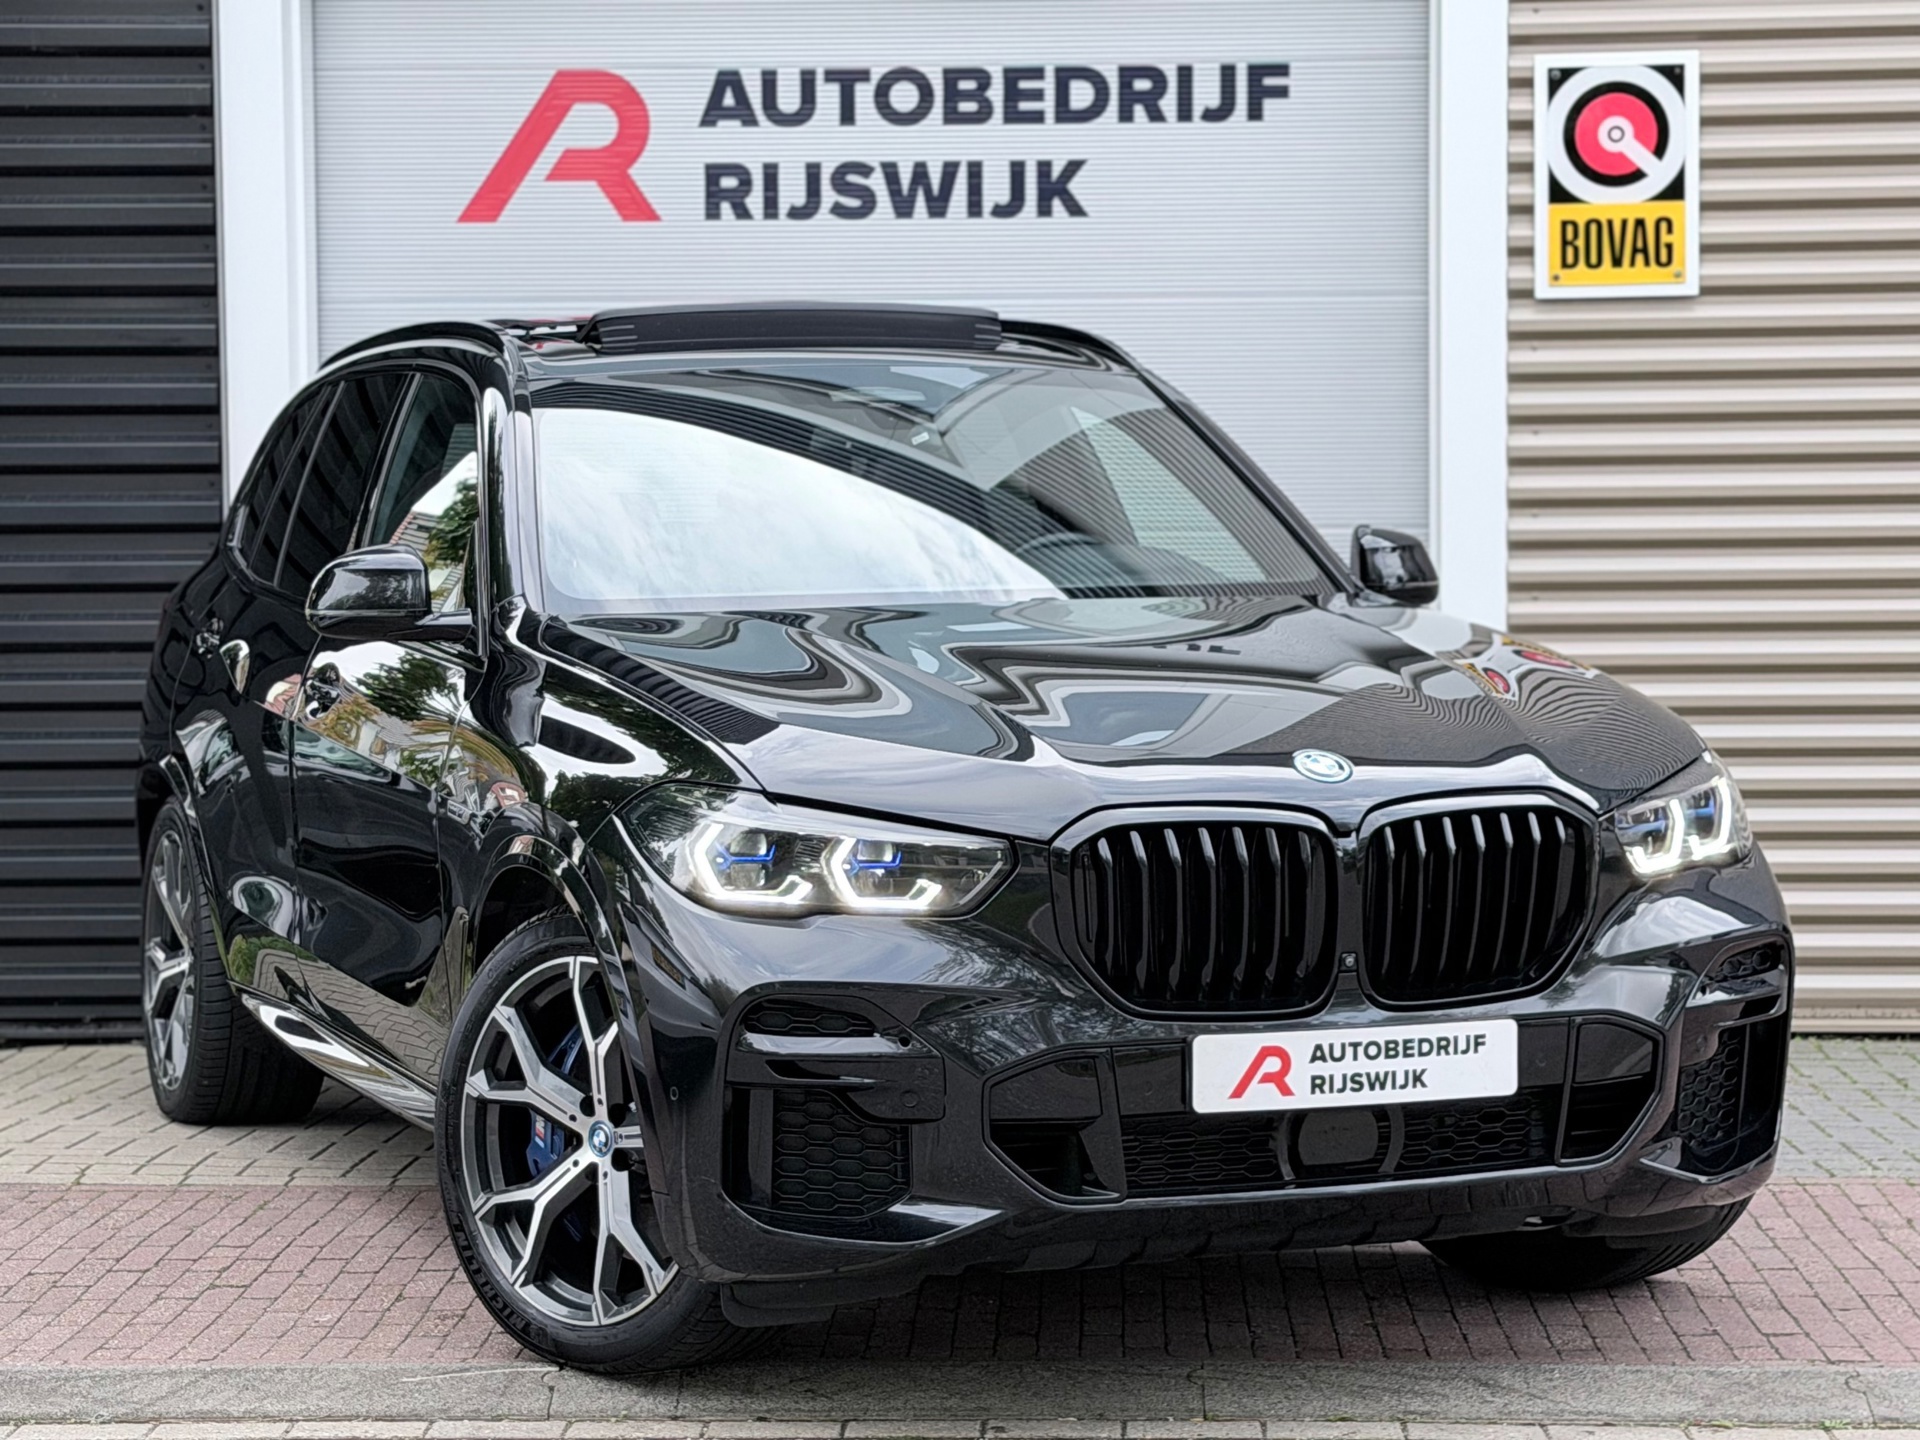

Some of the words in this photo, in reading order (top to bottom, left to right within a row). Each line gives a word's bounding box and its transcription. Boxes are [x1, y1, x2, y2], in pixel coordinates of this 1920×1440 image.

[699, 63, 1290, 128] AUTOBEDRIJF
[704, 159, 1088, 221] RIJSWIJK
[1560, 216, 1674, 269] BOVAG
[1308, 1034, 1487, 1064] AUTOBEDRIJF
[1309, 1068, 1428, 1095] RIJSWIJK
[453, 1230, 528, 1331] MICHELIN
